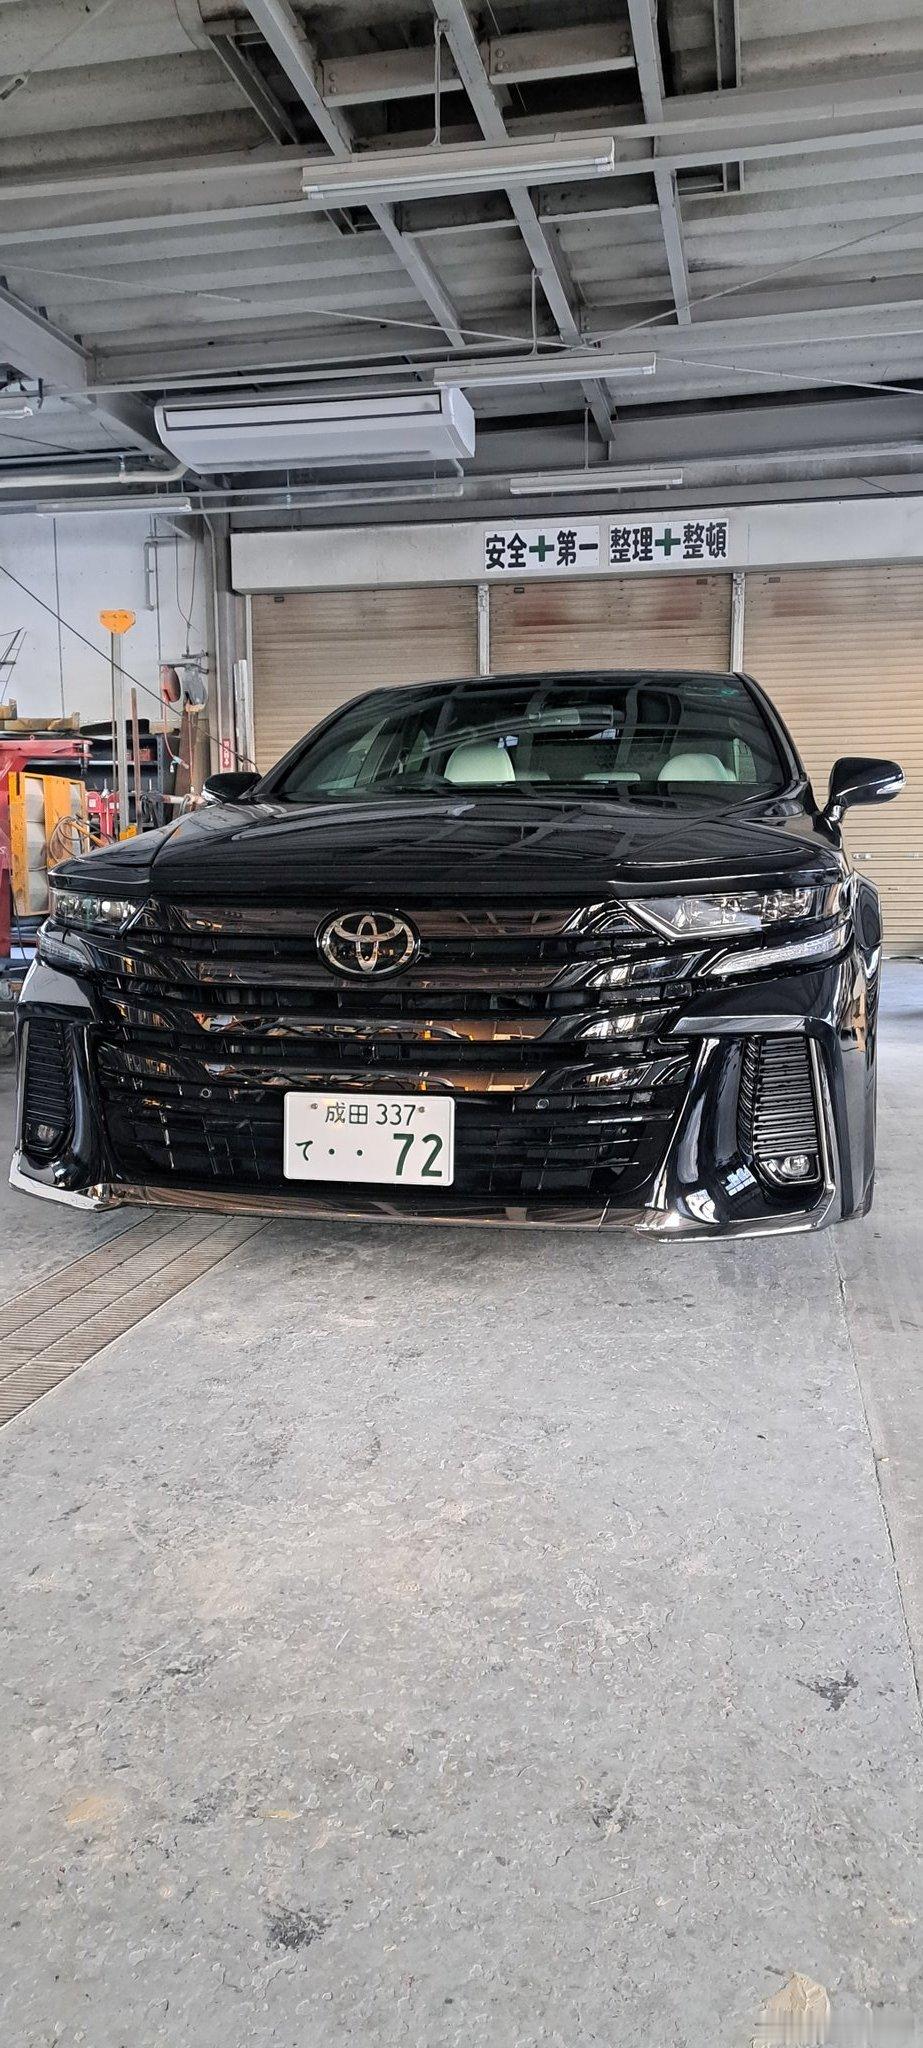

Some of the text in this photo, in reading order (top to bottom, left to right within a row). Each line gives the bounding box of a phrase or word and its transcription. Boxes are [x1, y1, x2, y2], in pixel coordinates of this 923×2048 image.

[486, 531, 598, 569] 安全 第一
[611, 522, 727, 563] 整理 整頓
[325, 1102, 416, 1126] 成田 337
[295, 1140, 313, 1161] て
[394, 1134, 442, 1177] 72
